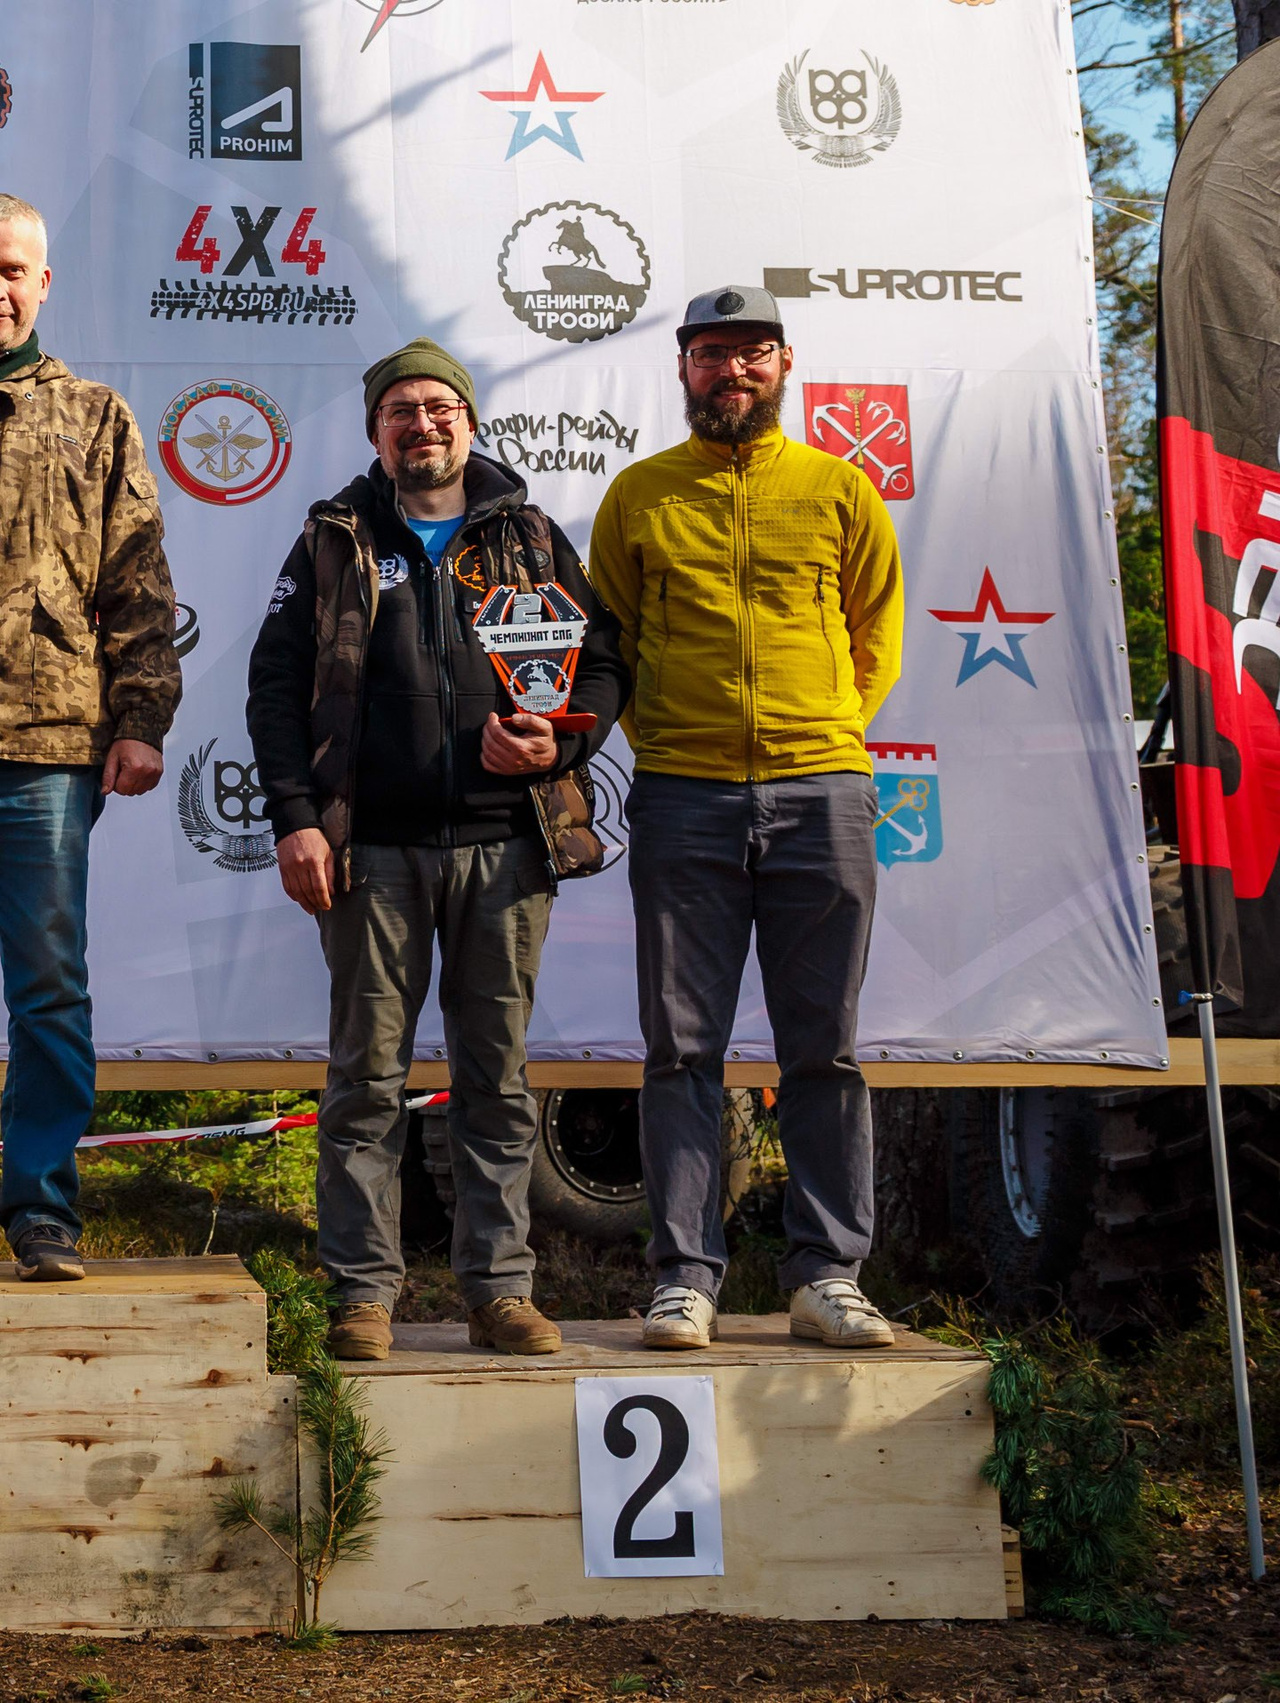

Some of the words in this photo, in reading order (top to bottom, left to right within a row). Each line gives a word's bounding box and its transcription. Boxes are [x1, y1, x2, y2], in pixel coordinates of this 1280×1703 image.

[189, 76, 204, 159] SUPROTEC
[220, 136, 293, 153] PROHIM
[194, 291, 306, 312] 4X4SPB.RU
[807, 267, 1023, 302] SUPROTEC
[524, 294, 630, 312] ЛЕНИНГРАД
[533, 312, 615, 329] ТРОФИ
[161, 382, 220, 438] ДОСААФ
[230, 383, 289, 438] РОССИИ
[476, 409, 639, 453] рофи-рейды
[603, 1394, 695, 1559] 2
